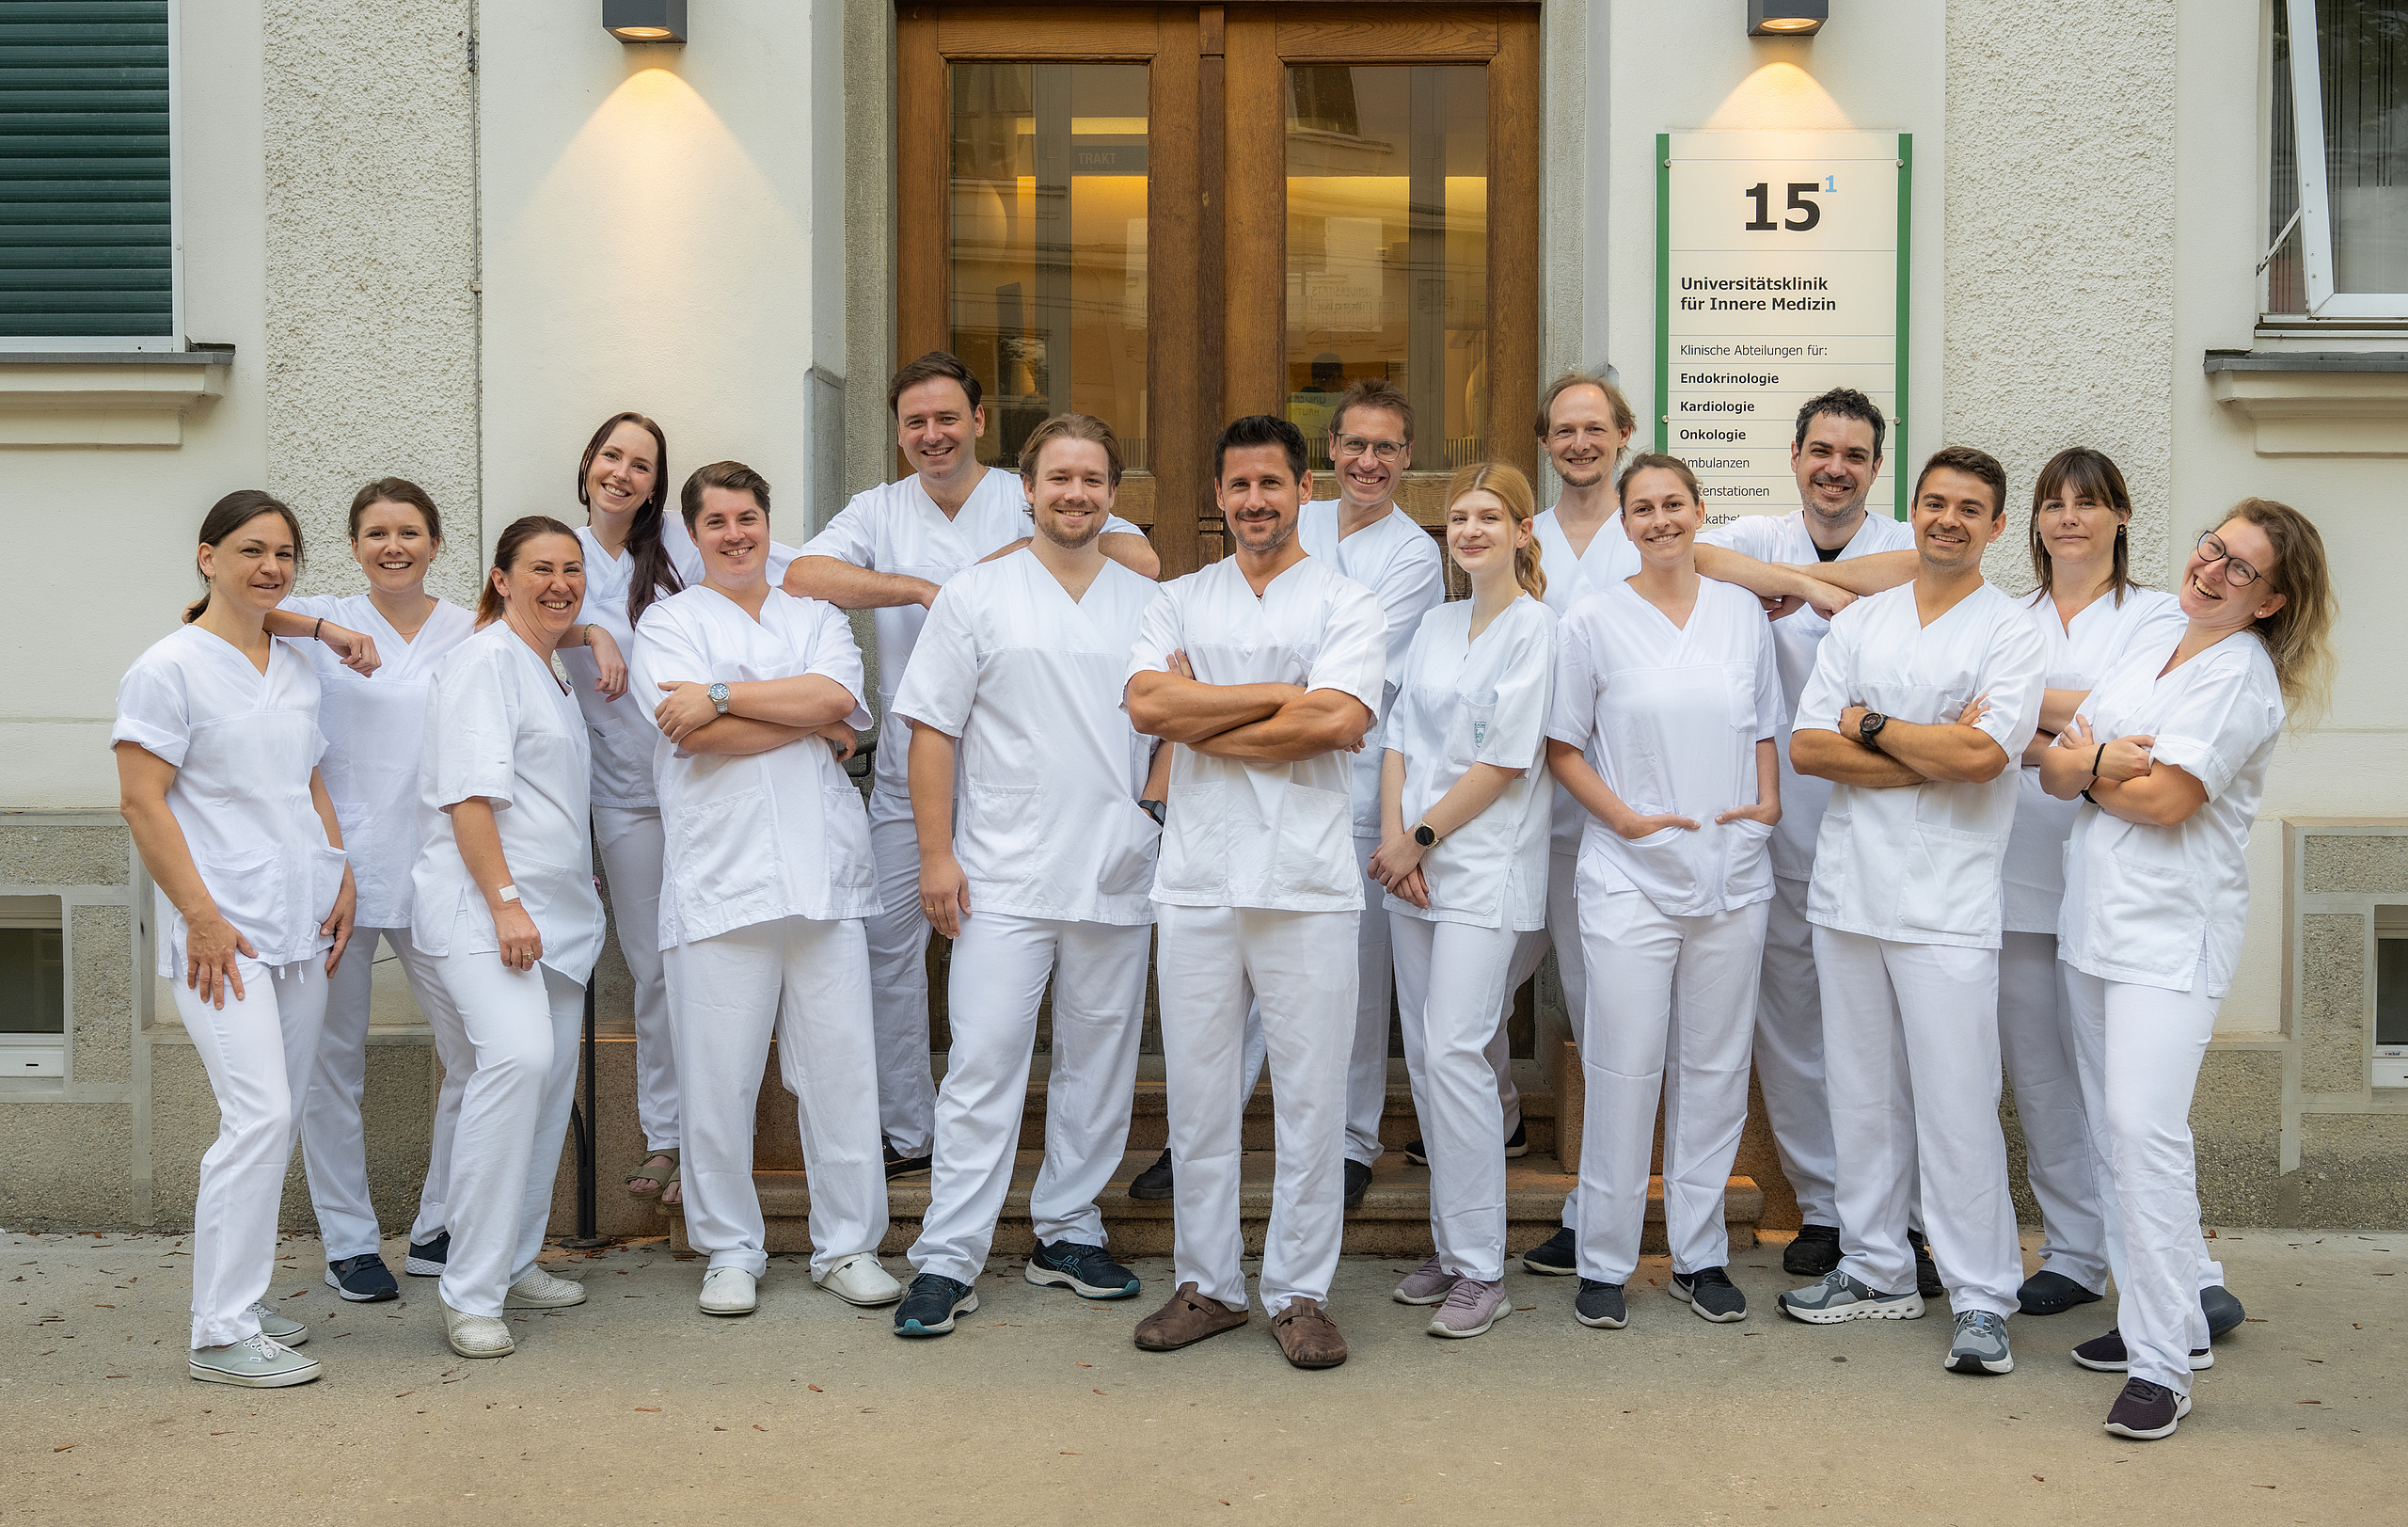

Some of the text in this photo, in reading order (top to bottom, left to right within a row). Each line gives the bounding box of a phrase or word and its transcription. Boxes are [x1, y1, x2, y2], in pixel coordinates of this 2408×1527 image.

[1077, 152, 1117, 165] TRAKT
[1745, 174, 1838, 231] 15 1
[1680, 276, 1829, 291] Universitätsklinik
[1680, 296, 1836, 310] für Innere Medizin
[1680, 343, 1828, 358] Klinische Abteilungen für:
[1680, 373, 1780, 387] Endokrinologie
[1680, 401, 1755, 414] Kardiologie
[1679, 429, 1747, 442] Onkologie
[1697, 485, 1770, 497] tenstationen
[1703, 513, 1740, 524] kathe
